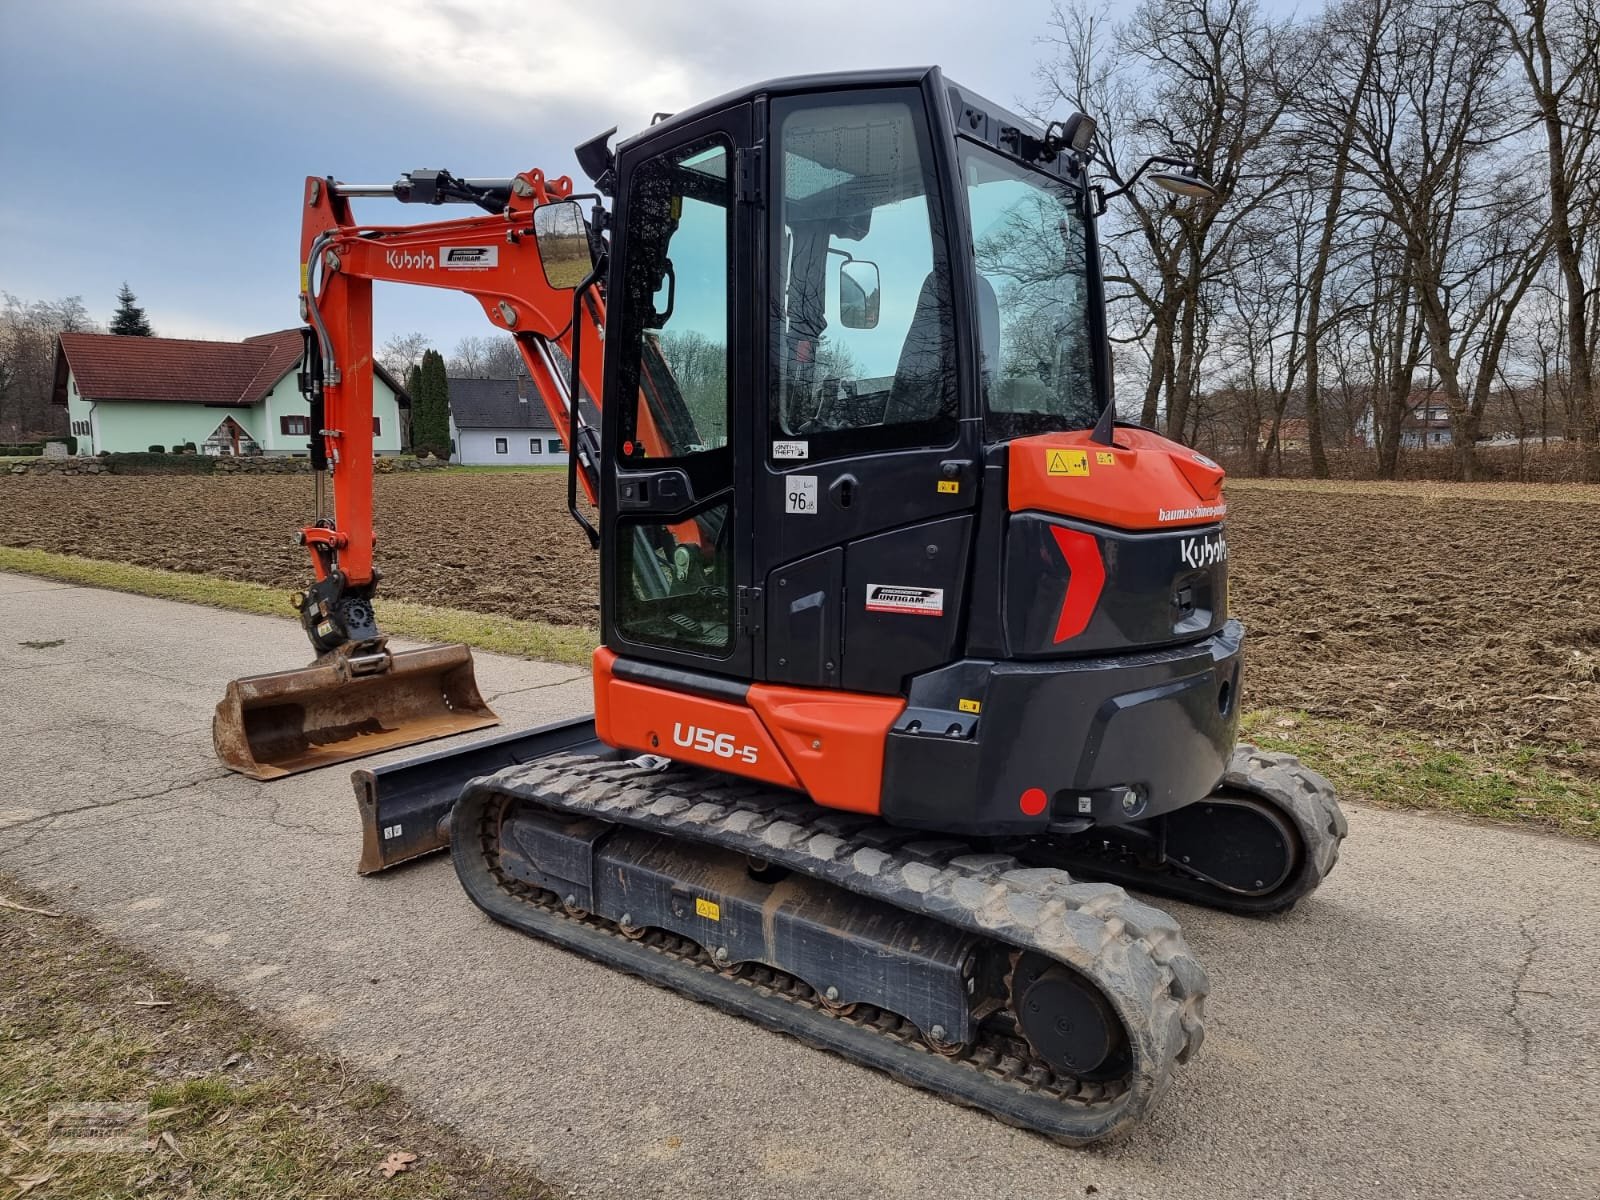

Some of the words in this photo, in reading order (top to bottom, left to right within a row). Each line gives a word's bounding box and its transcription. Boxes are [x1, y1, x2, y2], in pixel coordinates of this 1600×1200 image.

[386, 249, 435, 270] Kubota
[789, 492, 806, 510] 96
[871, 586, 928, 604] PUNTIGAM
[673, 722, 758, 764] U56-5
